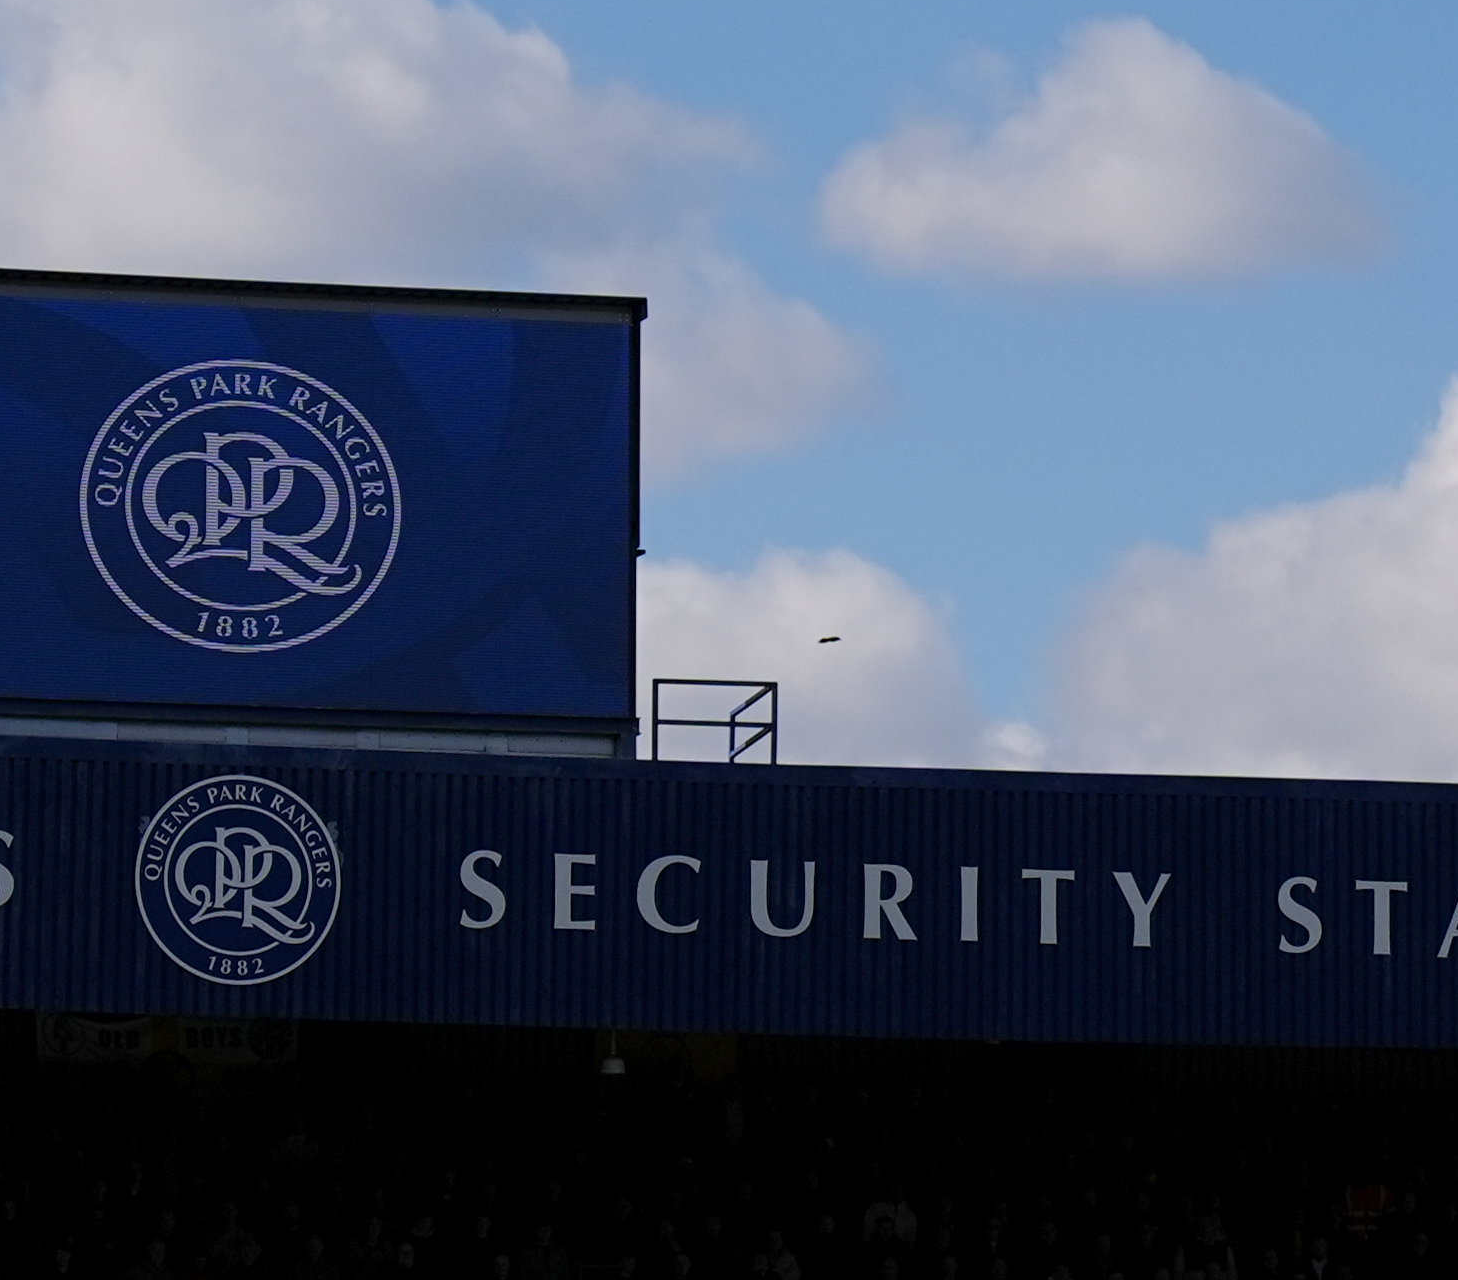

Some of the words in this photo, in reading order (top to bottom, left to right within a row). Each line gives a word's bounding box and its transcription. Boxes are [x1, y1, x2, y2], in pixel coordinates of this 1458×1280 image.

[95, 388, 179, 507] QUEENS
[190, 373, 277, 400] PARK
[288, 386, 387, 518] RANGERS
[197, 611, 284, 639] 1882
[144, 796, 199, 882] QUEENS
[207, 784, 264, 803] PARK
[270, 794, 332, 889] RANGERS
[459, 849, 1173, 948] SECURITY
[208, 956, 264, 976] 1882
